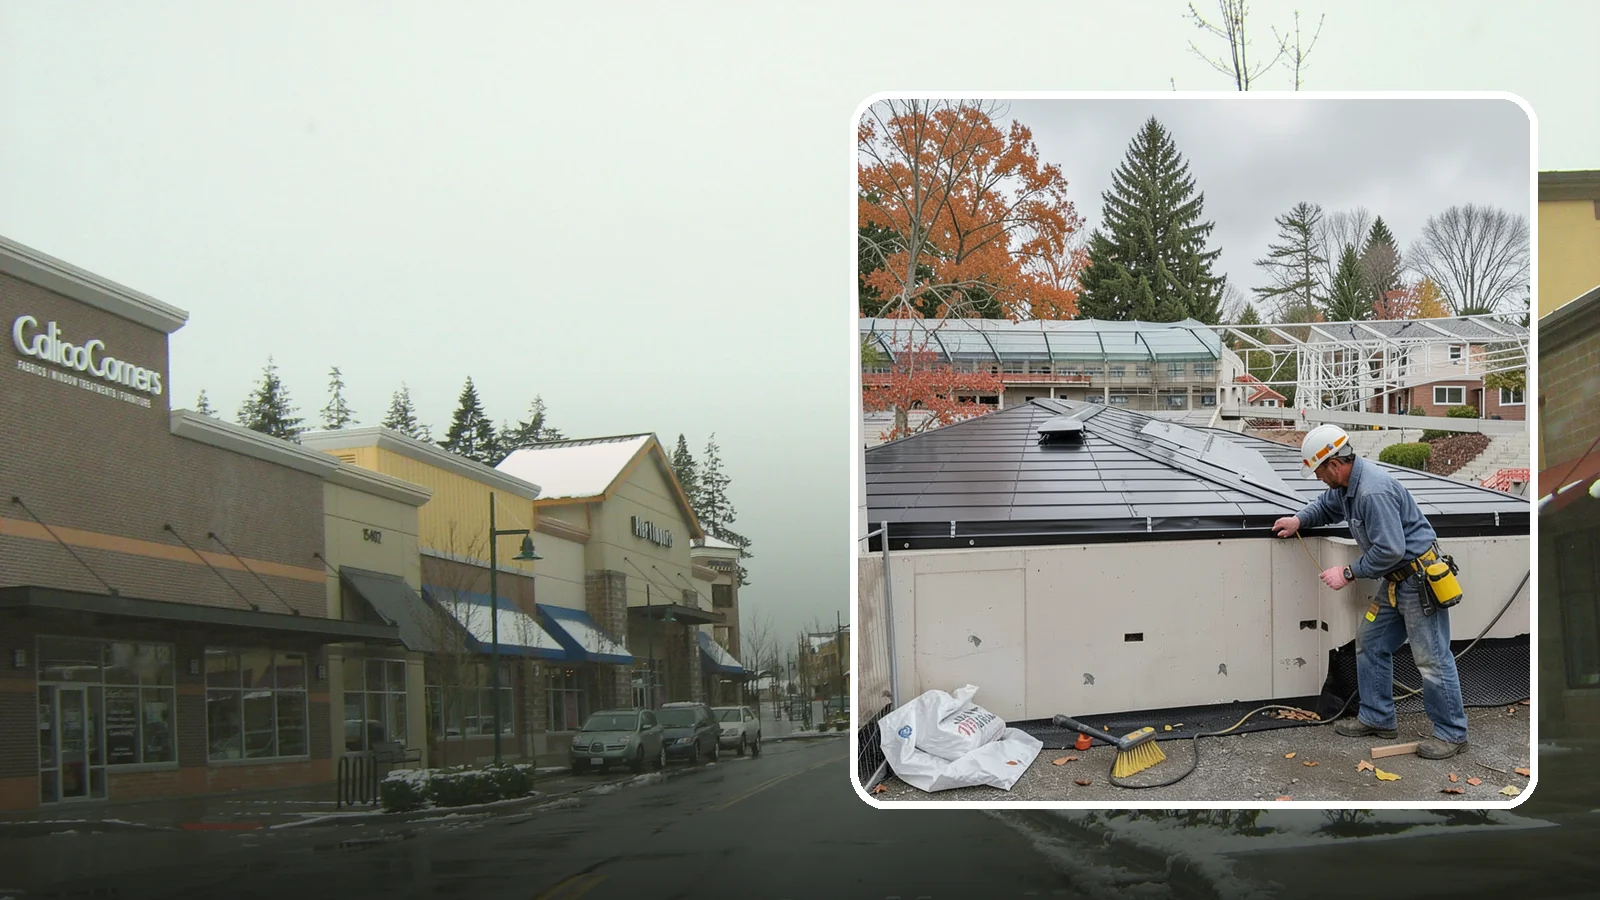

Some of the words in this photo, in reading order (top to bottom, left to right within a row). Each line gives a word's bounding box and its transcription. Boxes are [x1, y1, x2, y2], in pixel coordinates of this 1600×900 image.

[17, 360, 47, 378] FABRICS
[51, 370, 78, 386] WINDOW
[79, 378, 116, 398] TREATMENTS
